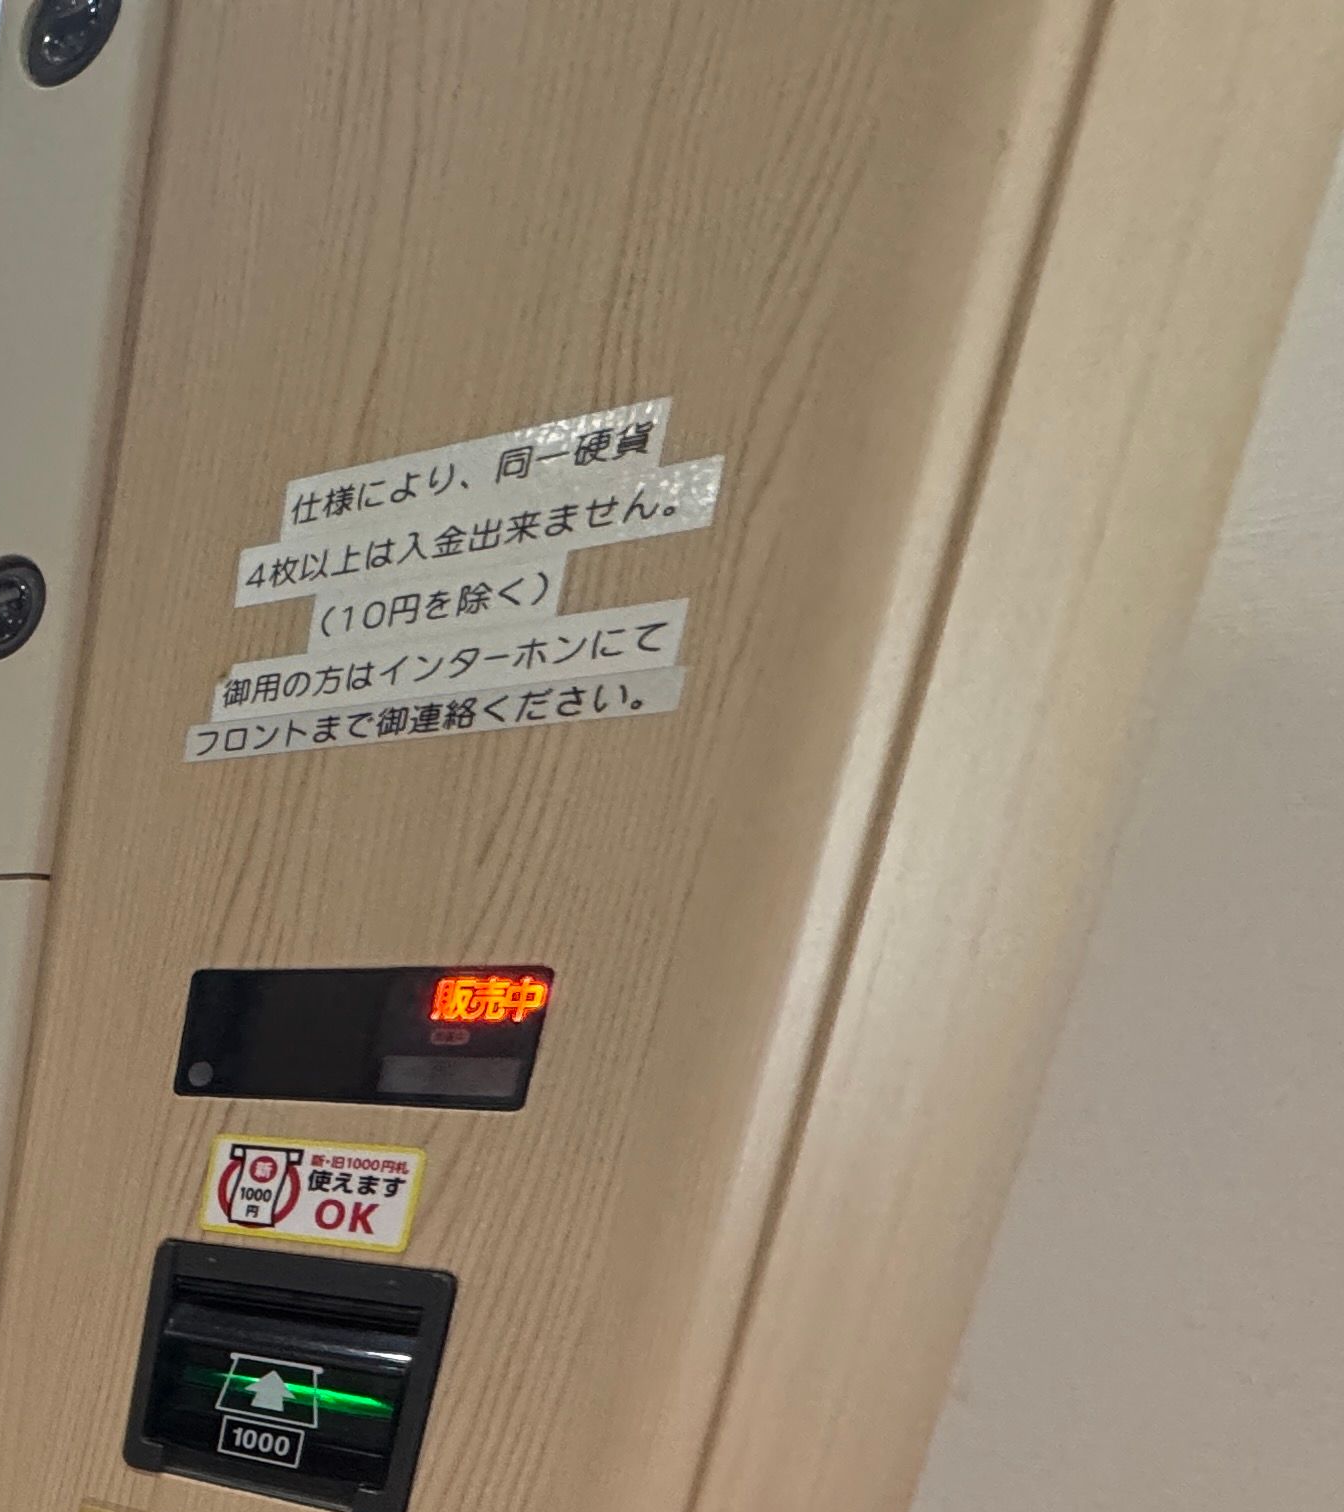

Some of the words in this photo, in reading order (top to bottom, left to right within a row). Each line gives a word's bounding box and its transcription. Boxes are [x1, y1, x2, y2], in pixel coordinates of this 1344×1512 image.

[292, 421, 653, 526] 仕様により、同一硬貨
[246, 493, 679, 590] 4枚以上は入金出来ません。
[321, 570, 552, 637] （10円を除く）
[223, 622, 669, 708] 御用の方はインターホンにて
[197, 684, 645, 756] フロントまで御連絡ください。
[430, 976, 549, 1023] 販売中
[241, 1186, 273, 1203] 1000
[308, 1169, 407, 1198] 使えます
[245, 1205, 259, 1218] 円
[315, 1199, 380, 1234] OK
[232, 1426, 290, 1457] 1000
